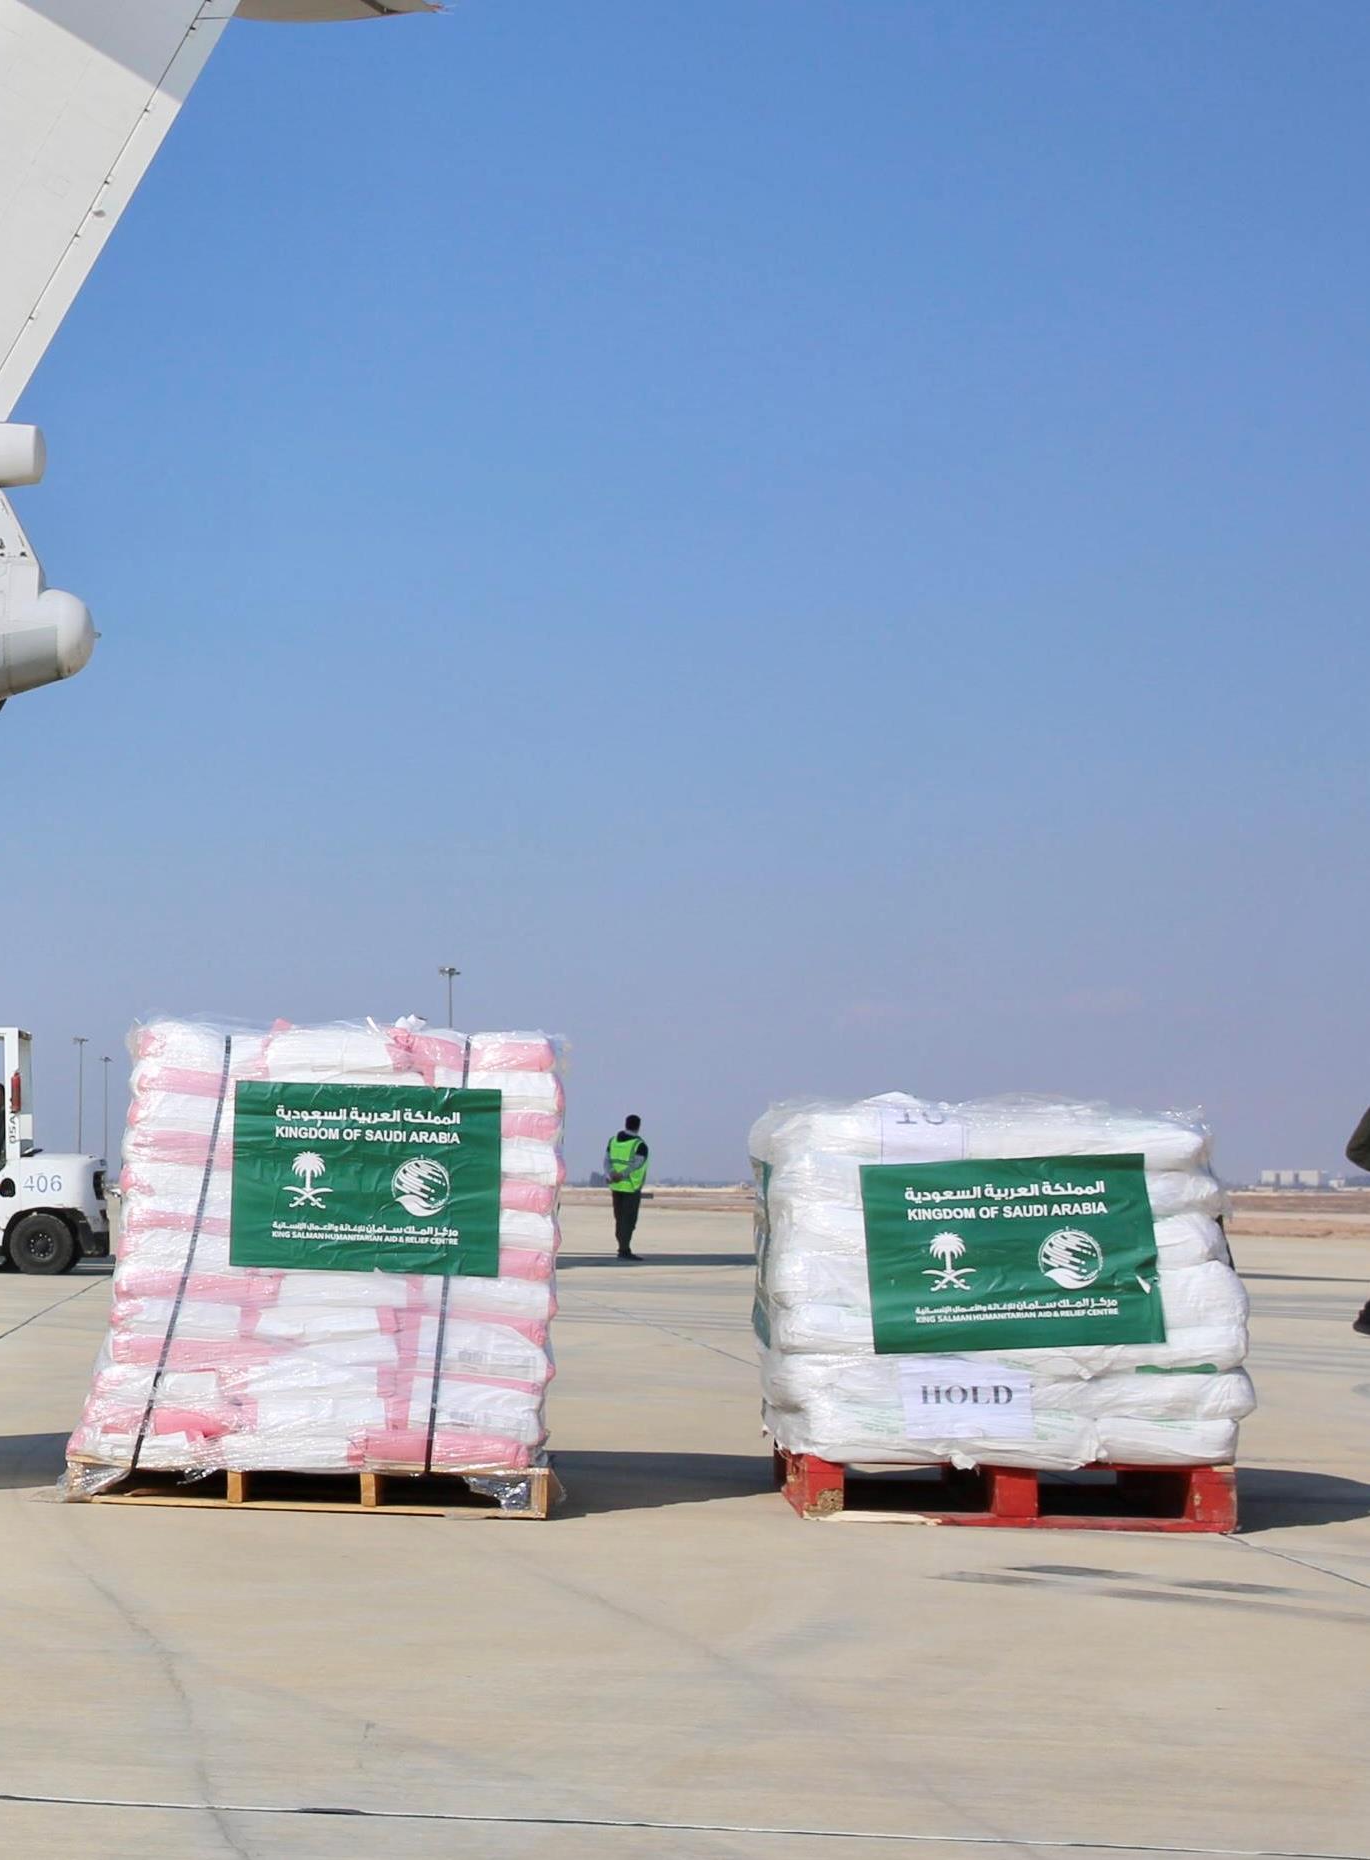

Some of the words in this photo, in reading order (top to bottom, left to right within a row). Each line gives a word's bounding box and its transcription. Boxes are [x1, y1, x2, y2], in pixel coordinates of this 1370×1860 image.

[276, 1104, 347, 1122] السعودية
[349, 1106, 401, 1124] العربية
[403, 1108, 461, 1125] المملكة
[275, 1126, 340, 1140] KINGDOM
[343, 1128, 361, 1141] OF
[364, 1129, 407, 1142] SAUDI
[408, 1130, 461, 1144] ARABIA
[22, 1174, 62, 1193] 406
[984, 1183, 1040, 1201] العربية
[1041, 1180, 1105, 1196] المملكة
[904, 1186, 982, 1204] السعودية
[907, 1207, 976, 1221] KINGDOM
[979, 1206, 999, 1219] OF
[1002, 1204, 1048, 1217] SAUDI
[1050, 1201, 1108, 1217] ARABIA
[271, 1230, 291, 1239] KING
[291, 1231, 325, 1239] SALMAN
[324, 1232, 383, 1242] HUMANITARIAN
[384, 1235, 398, 1243] AID
[405, 1236, 430, 1244] RELIEF
[429, 1237, 459, 1246] CENTRE
[916, 1315, 936, 1323] KING
[937, 1314, 972, 1323] SALMAN
[972, 1312, 1036, 1321] HUMANITARIAN
[1037, 1310, 1052, 1318] AID
[1060, 1309, 1086, 1318] RELIEF
[1086, 1307, 1119, 1316] CENTRE
[920, 1384, 1014, 1407] HOLD
